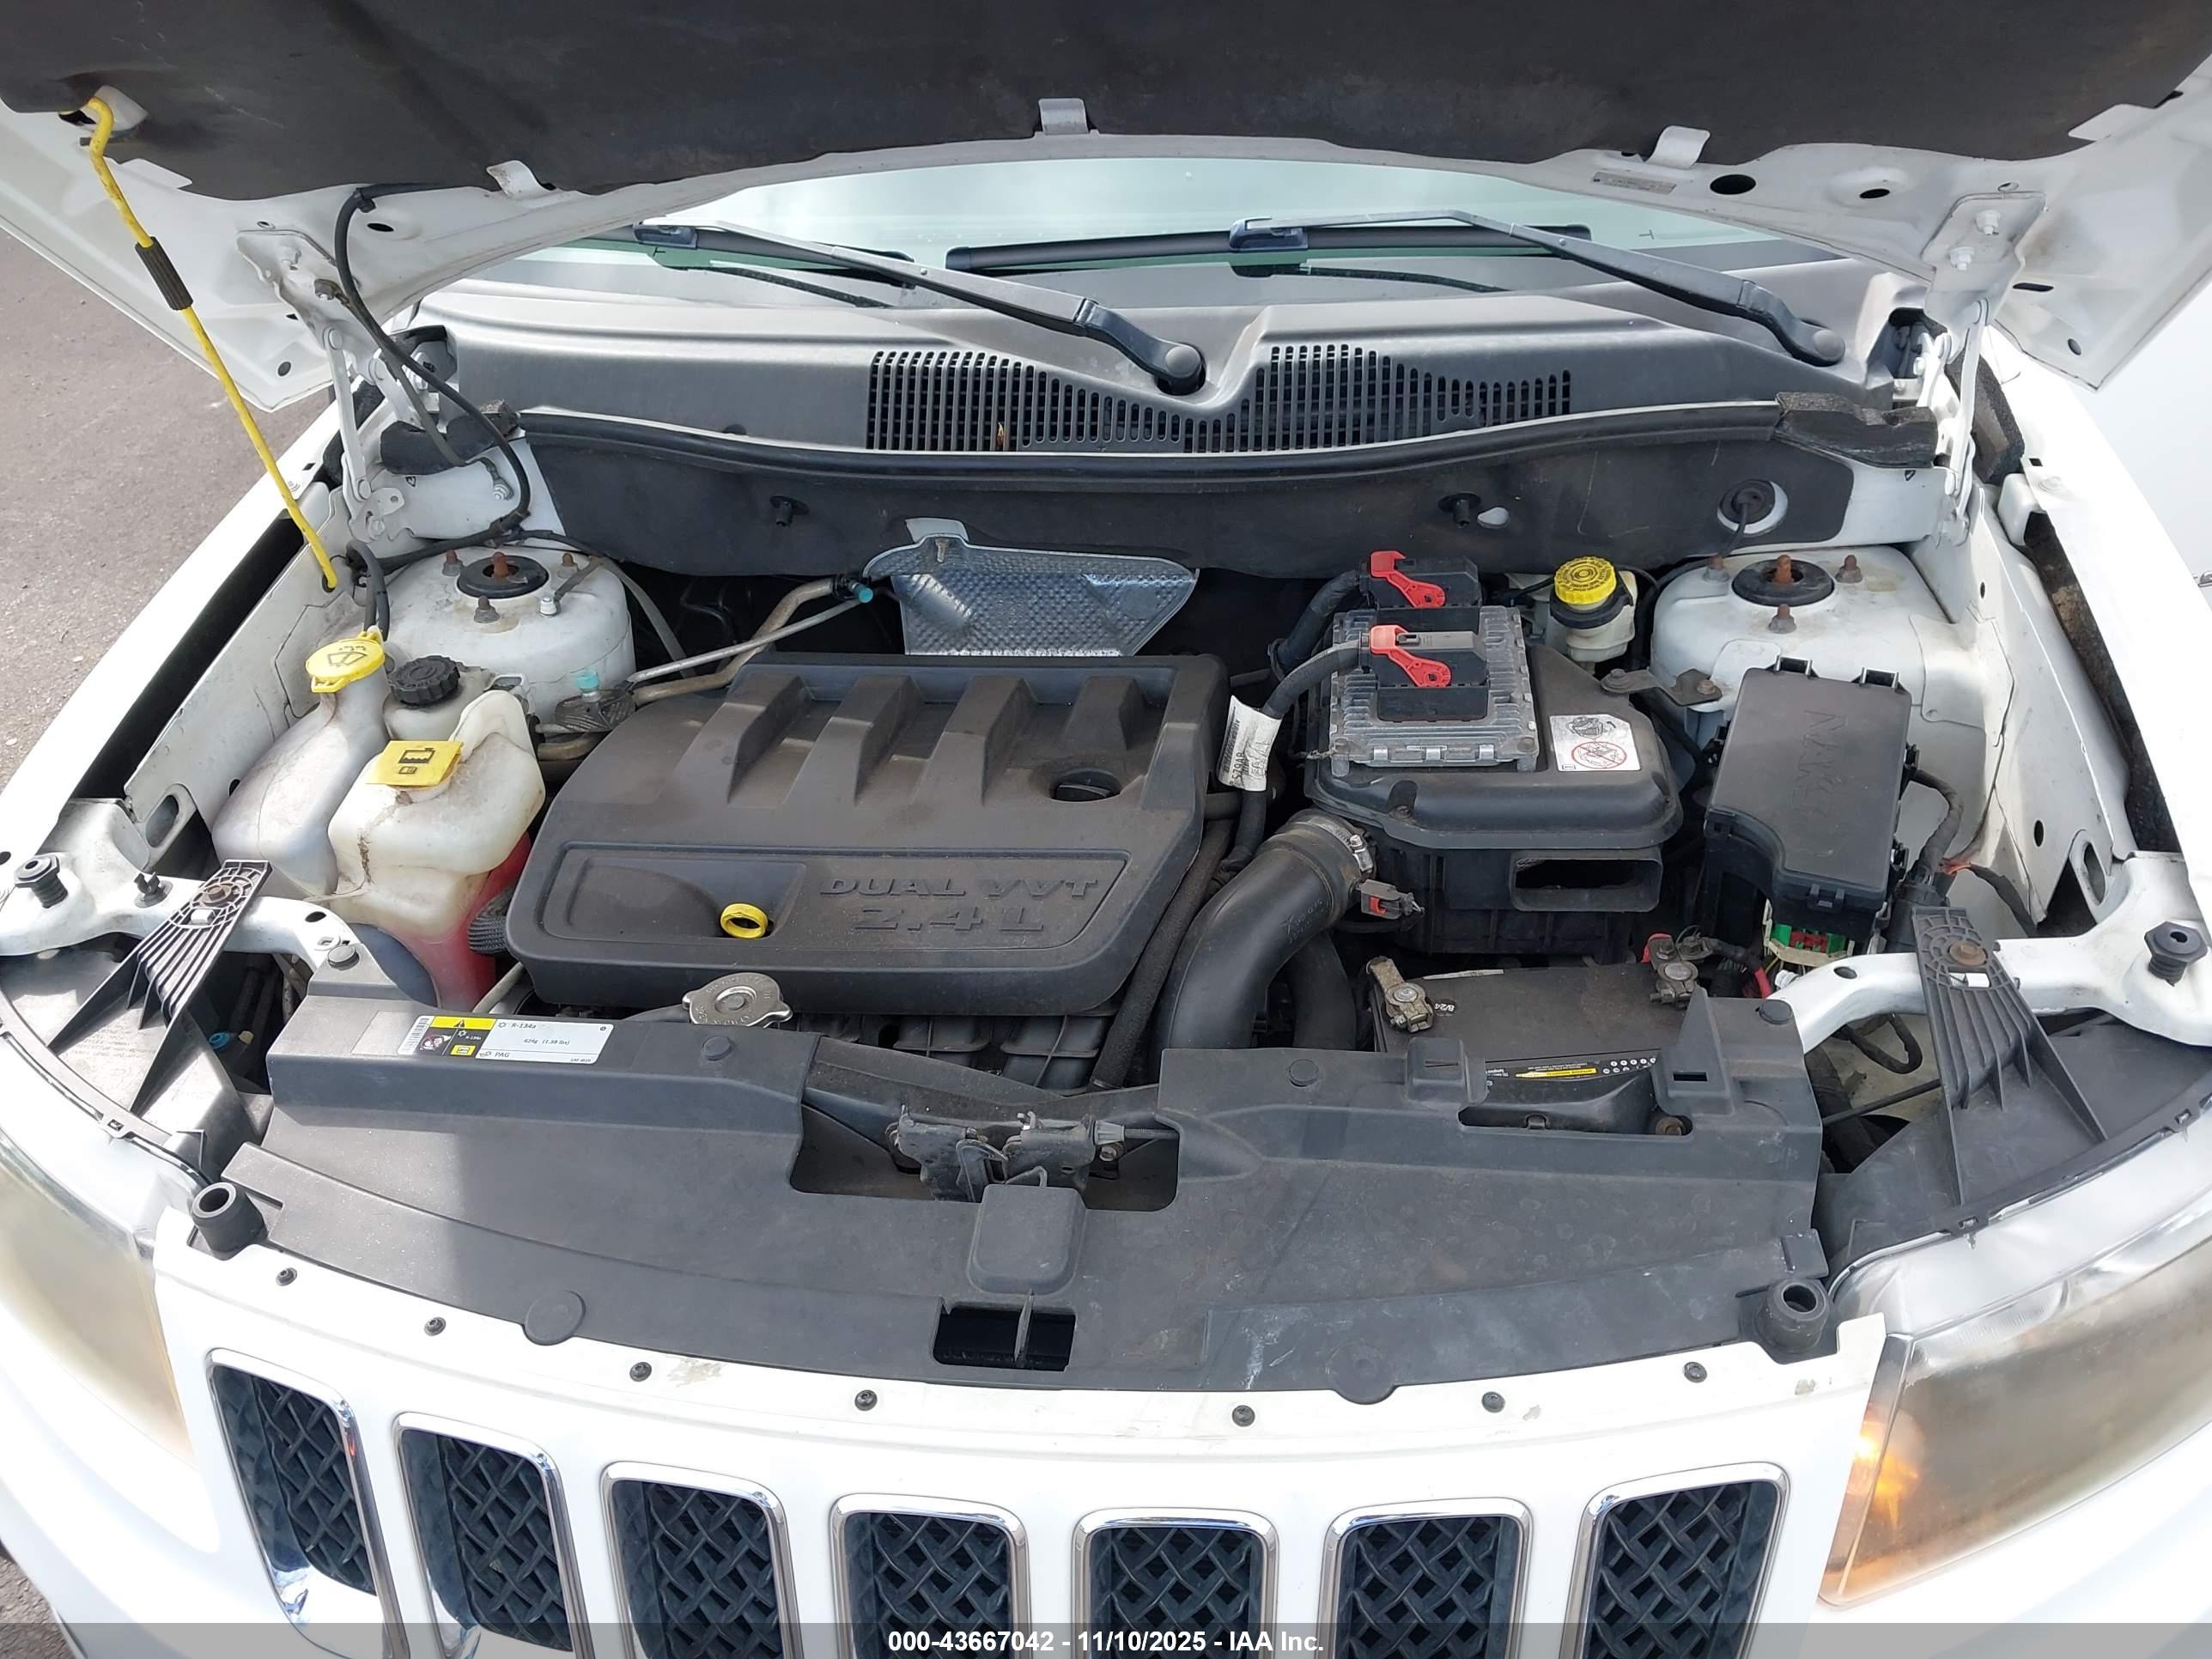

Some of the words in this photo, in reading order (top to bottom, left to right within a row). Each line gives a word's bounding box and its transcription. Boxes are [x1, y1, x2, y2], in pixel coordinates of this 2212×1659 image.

[820, 878, 965, 896] DUAL
[979, 878, 1099, 898] VVT
[1435, 1003, 1455, 1012] 8/24
